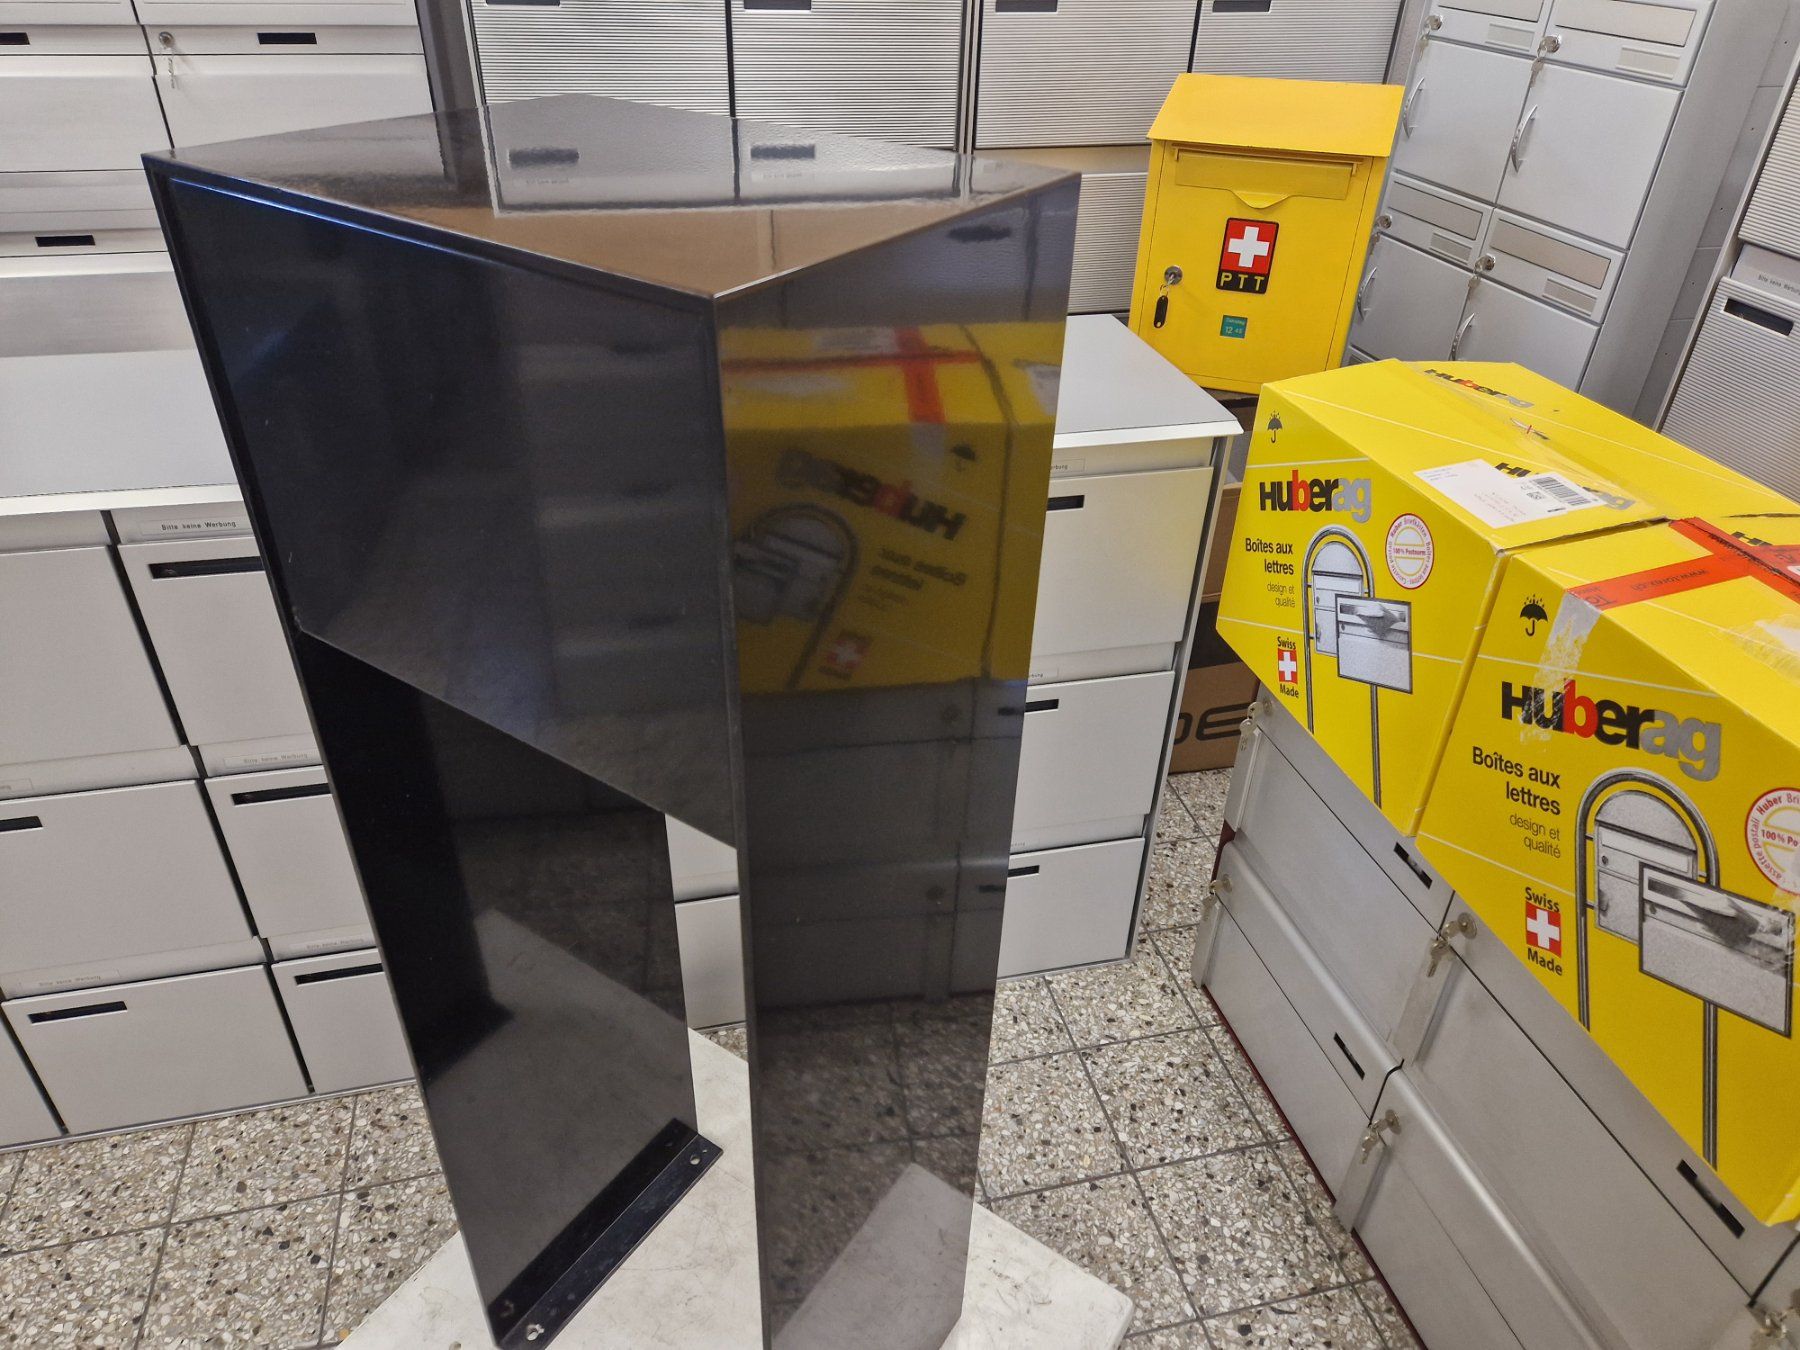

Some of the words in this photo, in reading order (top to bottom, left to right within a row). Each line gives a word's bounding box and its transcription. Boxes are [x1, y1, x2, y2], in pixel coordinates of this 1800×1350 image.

[1220, 272, 1264, 291] PTT
[1259, 469, 1372, 523] Huberag
[1245, 537, 1274, 554] Boîtes
[1276, 542, 1293, 555] aux
[1264, 558, 1294, 575] lettres
[1267, 582, 1287, 596] design
[1286, 585, 1295, 594] et
[1277, 636, 1296, 650] Swiss
[1280, 683, 1299, 698] Made
[1501, 679, 1722, 782] Huberag
[1472, 746, 1524, 777] Boîtes
[1529, 767, 1560, 789] aux
[1505, 781, 1561, 815] lettres
[1756, 795, 1782, 815] Huber
[1509, 812, 1546, 836] design
[1549, 828, 1560, 841] et
[1524, 835, 1561, 859] qualité
[1525, 887, 1560, 913] Swiss
[1527, 947, 1563, 976] Made
